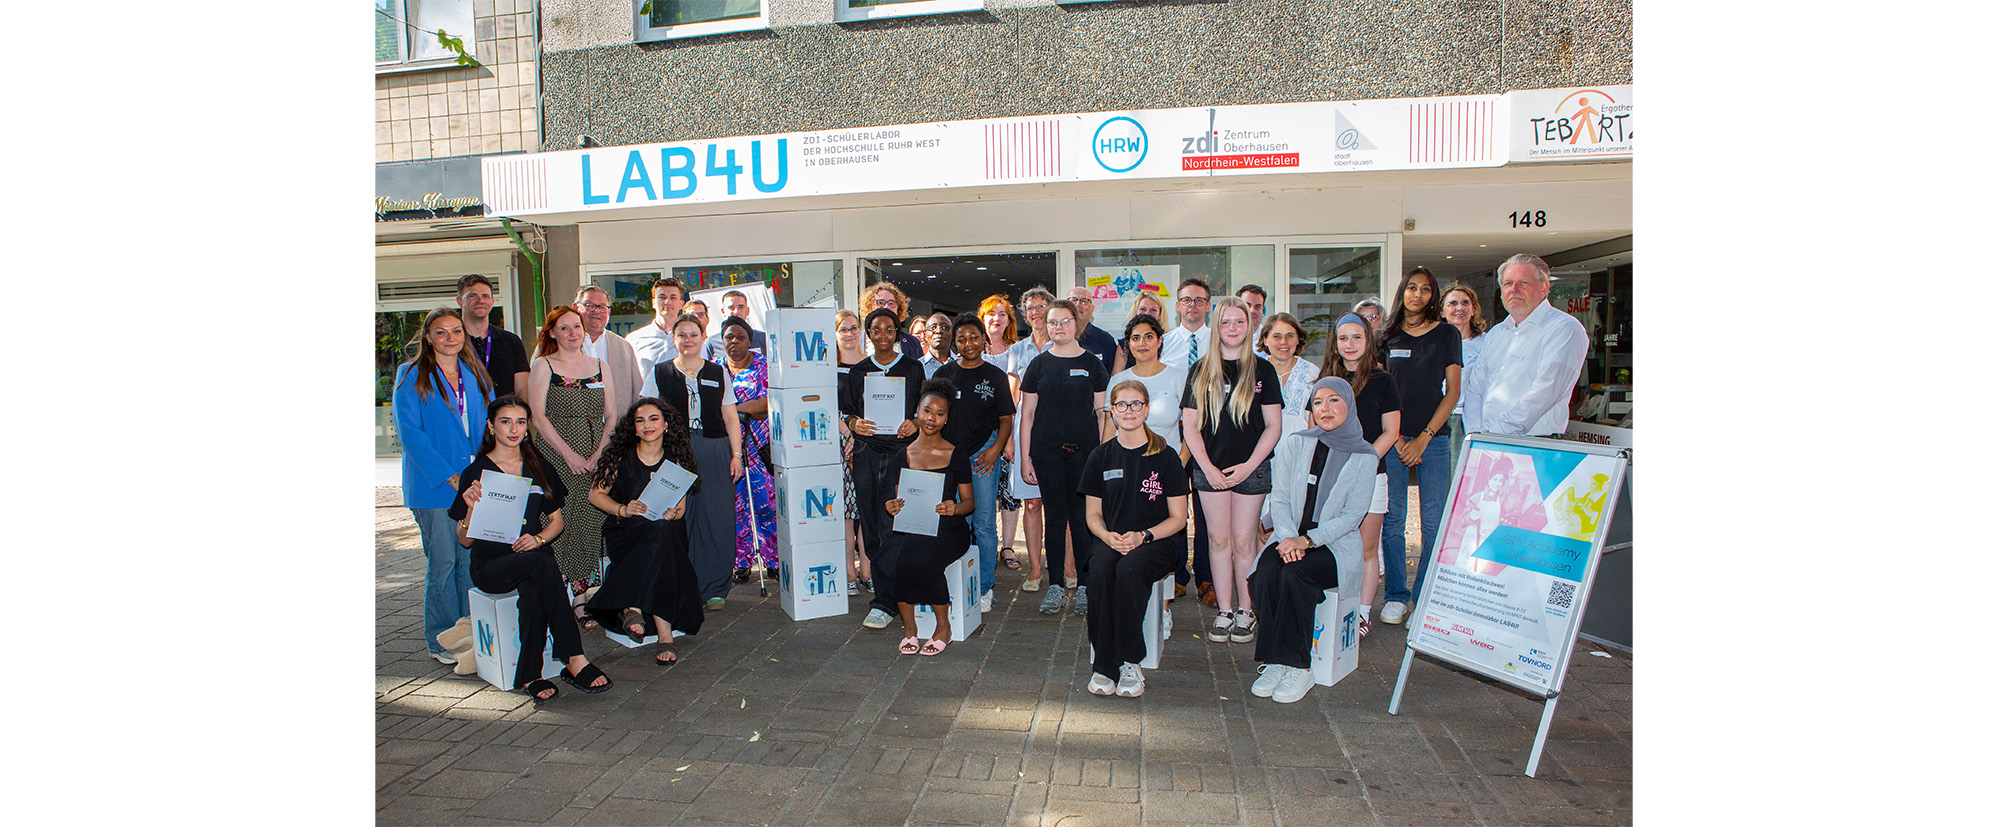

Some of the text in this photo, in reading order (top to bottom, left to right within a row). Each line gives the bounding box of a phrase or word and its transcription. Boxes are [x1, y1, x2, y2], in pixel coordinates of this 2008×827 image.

[1182, 115, 1218, 154] zdi
[1224, 129, 1270, 140] Zentrum
[1530, 107, 1632, 146] TEBART
[803, 139, 940, 156] DER HOCHSCHULE RUHR WEST
[1100, 136, 1140, 153] HRW
[1224, 141, 1288, 153] Oberhausen
[804, 154, 879, 167] IN OBERHAUSEN
[1184, 156, 1298, 169] Nordrhein-Westfalen
[582, 138, 788, 205] LAB4U
[1508, 210, 1547, 228] 148
[1567, 296, 1591, 314] SALE
[796, 332, 822, 361] M
[1578, 431, 1610, 445] HEMSING
[806, 488, 828, 518] N
[1503, 534, 1581, 561] Girls' Academy
[1505, 549, 1571, 572] Oberhausen
[809, 565, 831, 594] T
[1437, 575, 1458, 584] Mädchen
[1458, 580, 1476, 590] können
[478, 620, 492, 656] N
